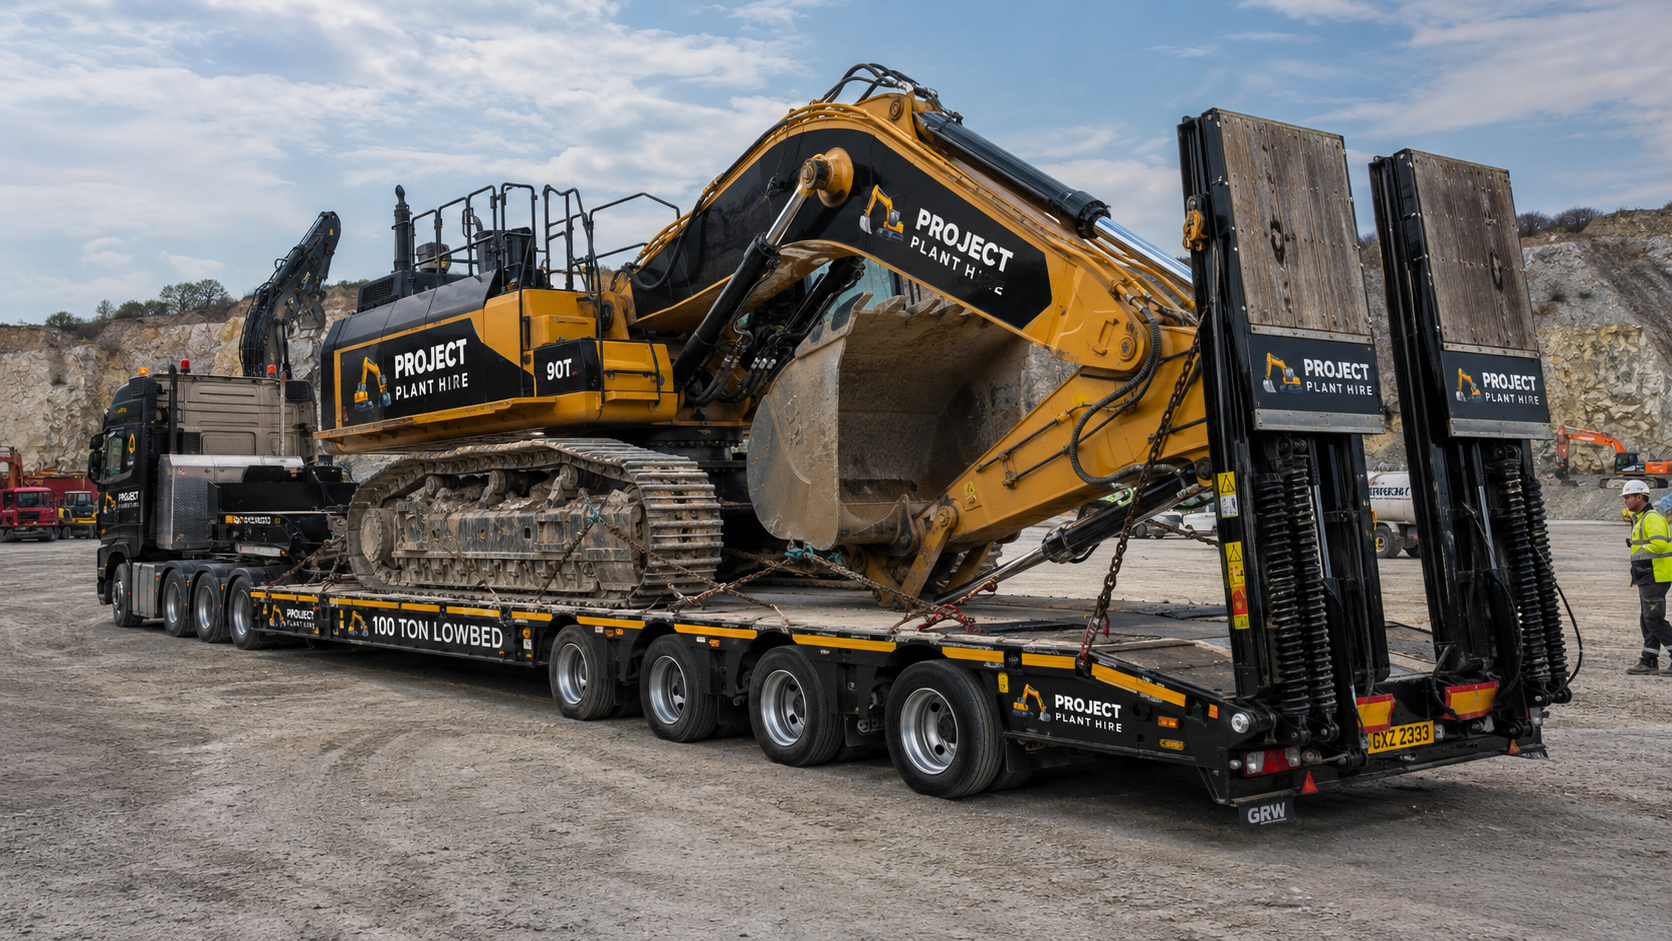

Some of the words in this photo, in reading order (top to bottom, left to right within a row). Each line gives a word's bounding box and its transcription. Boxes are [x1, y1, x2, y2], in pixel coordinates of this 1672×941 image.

[915, 208, 1014, 272] PROJECT
[910, 235, 961, 270] PLANT
[394, 338, 467, 379] PROJECT
[546, 358, 572, 381] 90T
[1303, 358, 1369, 380] PROJECT
[395, 380, 434, 400] PLANT
[438, 372, 469, 392] HIRE
[1306, 381, 1342, 394] PLANT
[1346, 384, 1373, 396] HIRE
[1482, 372, 1536, 391] PROJECT
[1485, 392, 1515, 403] PLANT
[1518, 394, 1540, 405] HIRE
[372, 615, 395, 636] 100
[398, 618, 429, 640] TON
[433, 621, 503, 649] LOWBED
[1054, 694, 1122, 719] PROJECT
[1055, 712, 1091, 727] PLANT
[1095, 720, 1122, 733] HIRE
[1372, 729, 1396, 749] GXZ
[1399, 724, 1429, 746] 2333
[1247, 802, 1286, 824] GRW
